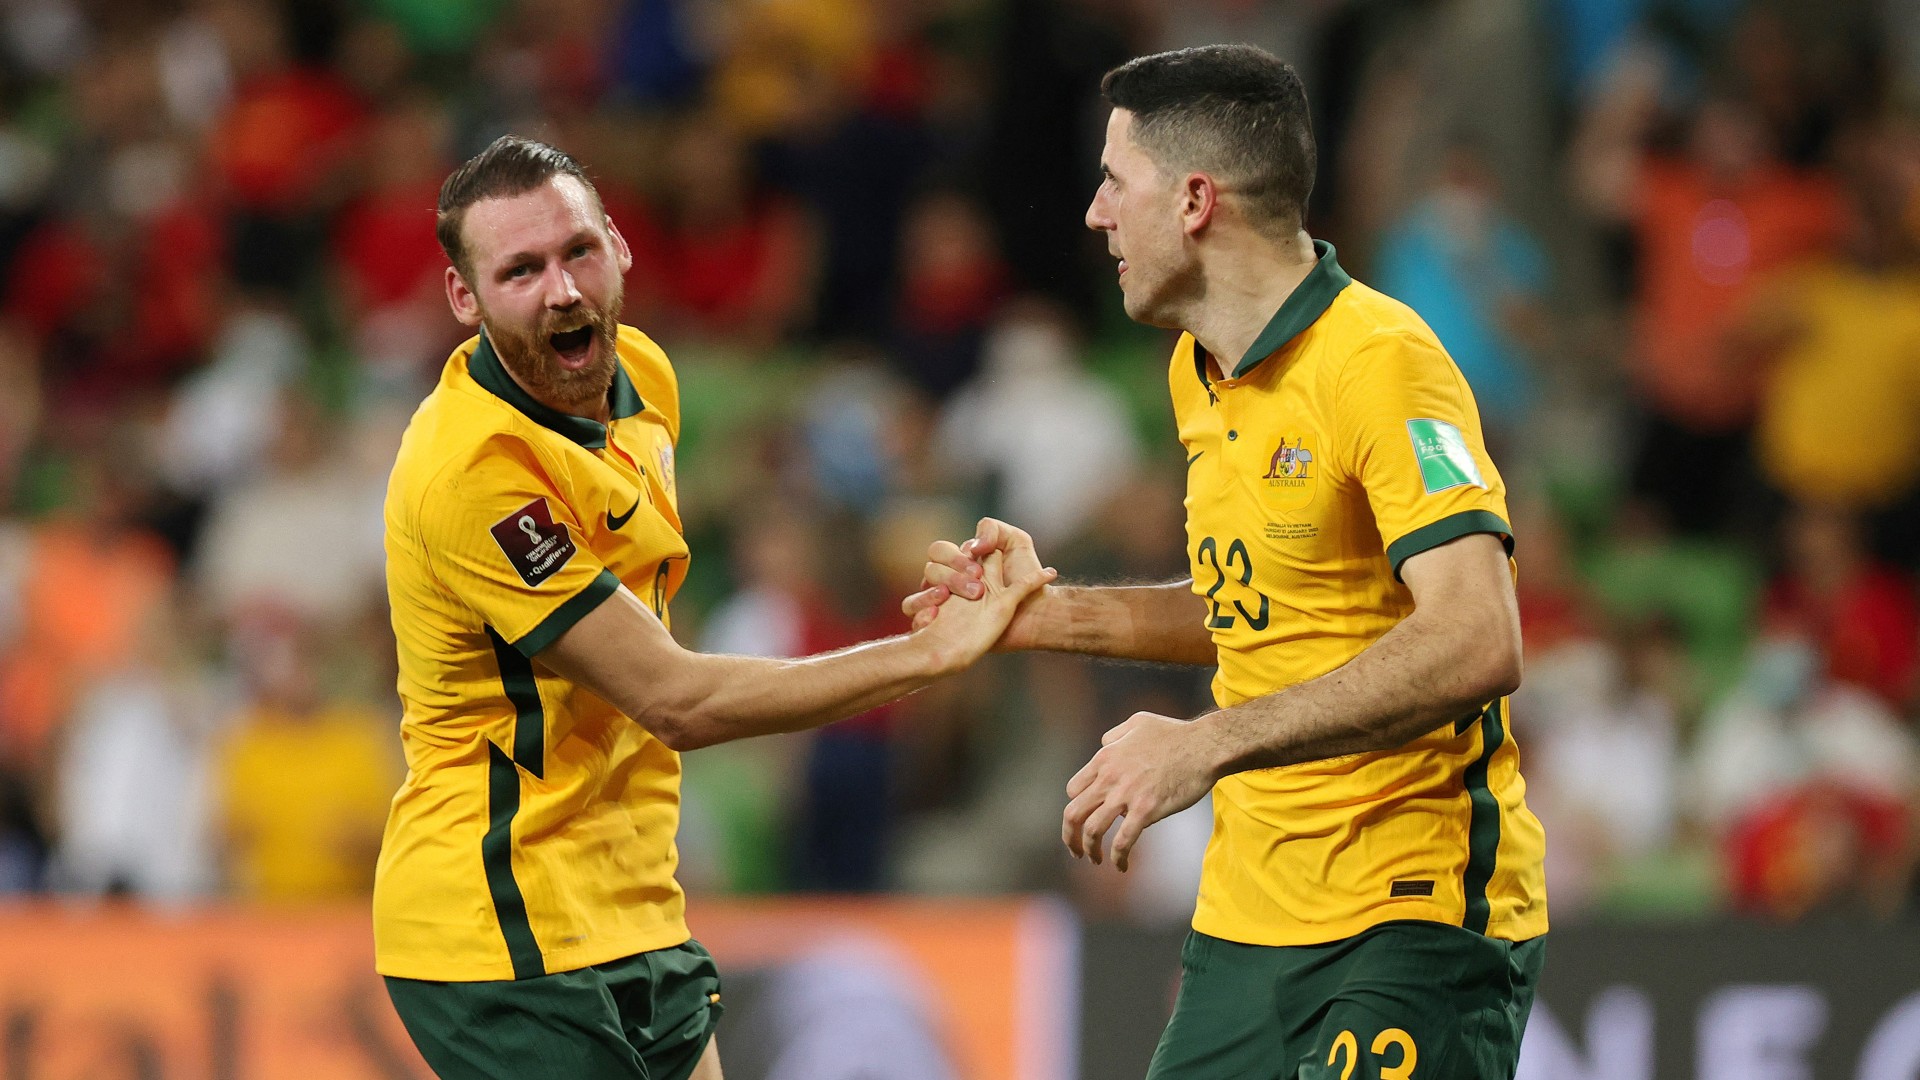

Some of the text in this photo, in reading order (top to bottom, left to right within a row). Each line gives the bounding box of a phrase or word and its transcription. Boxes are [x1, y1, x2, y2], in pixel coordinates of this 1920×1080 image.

[532, 545, 567, 574] Qualifiers
[1198, 537, 1269, 631] 23
[1328, 1028, 1418, 1080] 23
